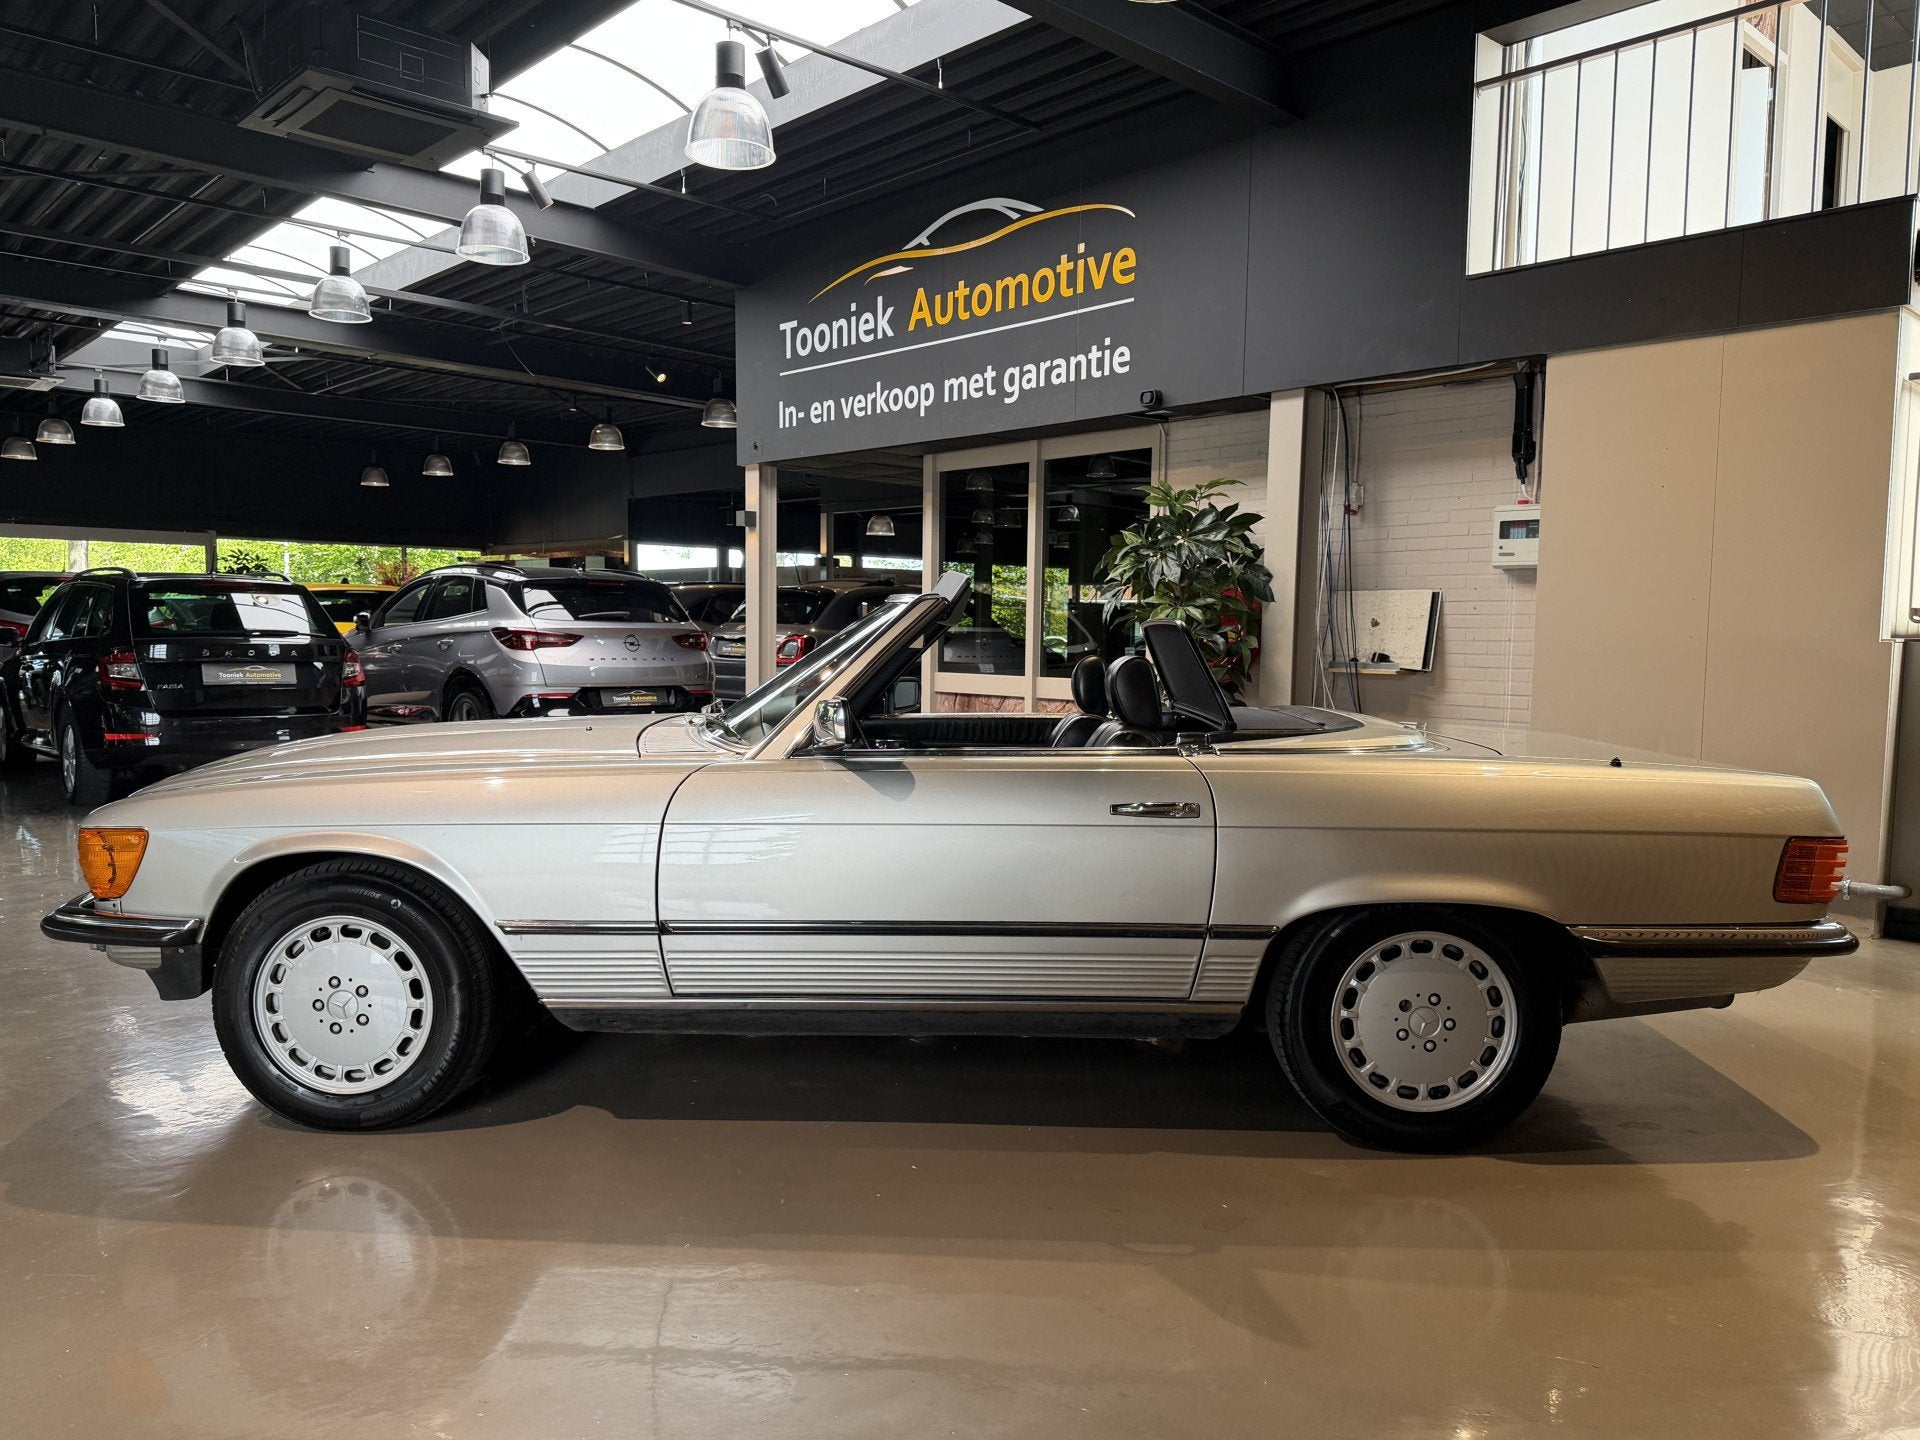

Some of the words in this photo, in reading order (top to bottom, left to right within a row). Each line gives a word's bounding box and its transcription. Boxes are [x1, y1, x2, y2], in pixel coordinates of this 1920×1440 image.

[779, 295, 895, 360] Tooniek
[907, 242, 1137, 332] Automotive
[778, 400, 805, 429] In-
[810, 398, 836, 426] en
[840, 381, 935, 418] verkoop
[944, 365, 997, 404] met
[1003, 336, 1131, 405] garantie
[347, 887, 382, 900] OUTSIDE
